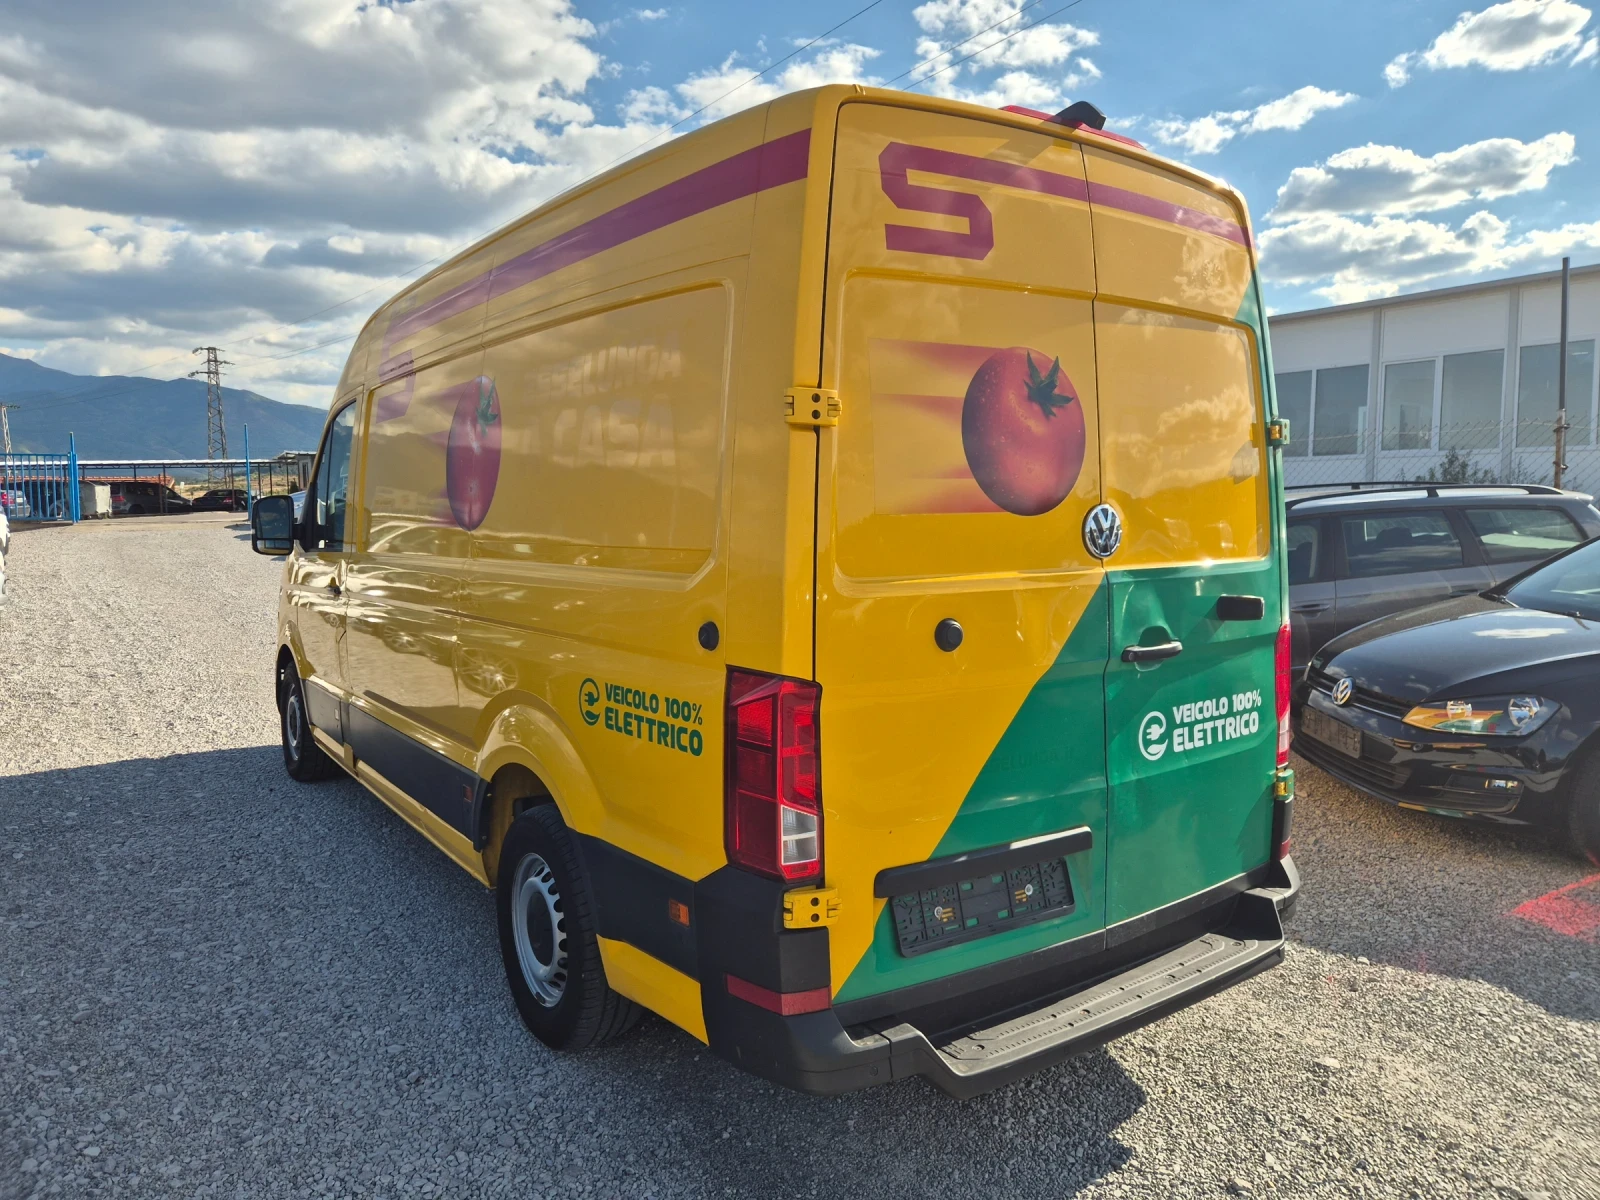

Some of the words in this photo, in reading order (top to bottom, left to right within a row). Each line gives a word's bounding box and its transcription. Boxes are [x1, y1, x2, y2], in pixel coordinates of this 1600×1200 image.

[604, 682, 660, 715] VEICOLO
[664, 696, 703, 726] 100%
[1172, 696, 1229, 725] VEICOLO
[1232, 689, 1262, 713] 100%
[604, 706, 703, 757] ELETTRICO
[1172, 711, 1260, 753] ELETTRICO
